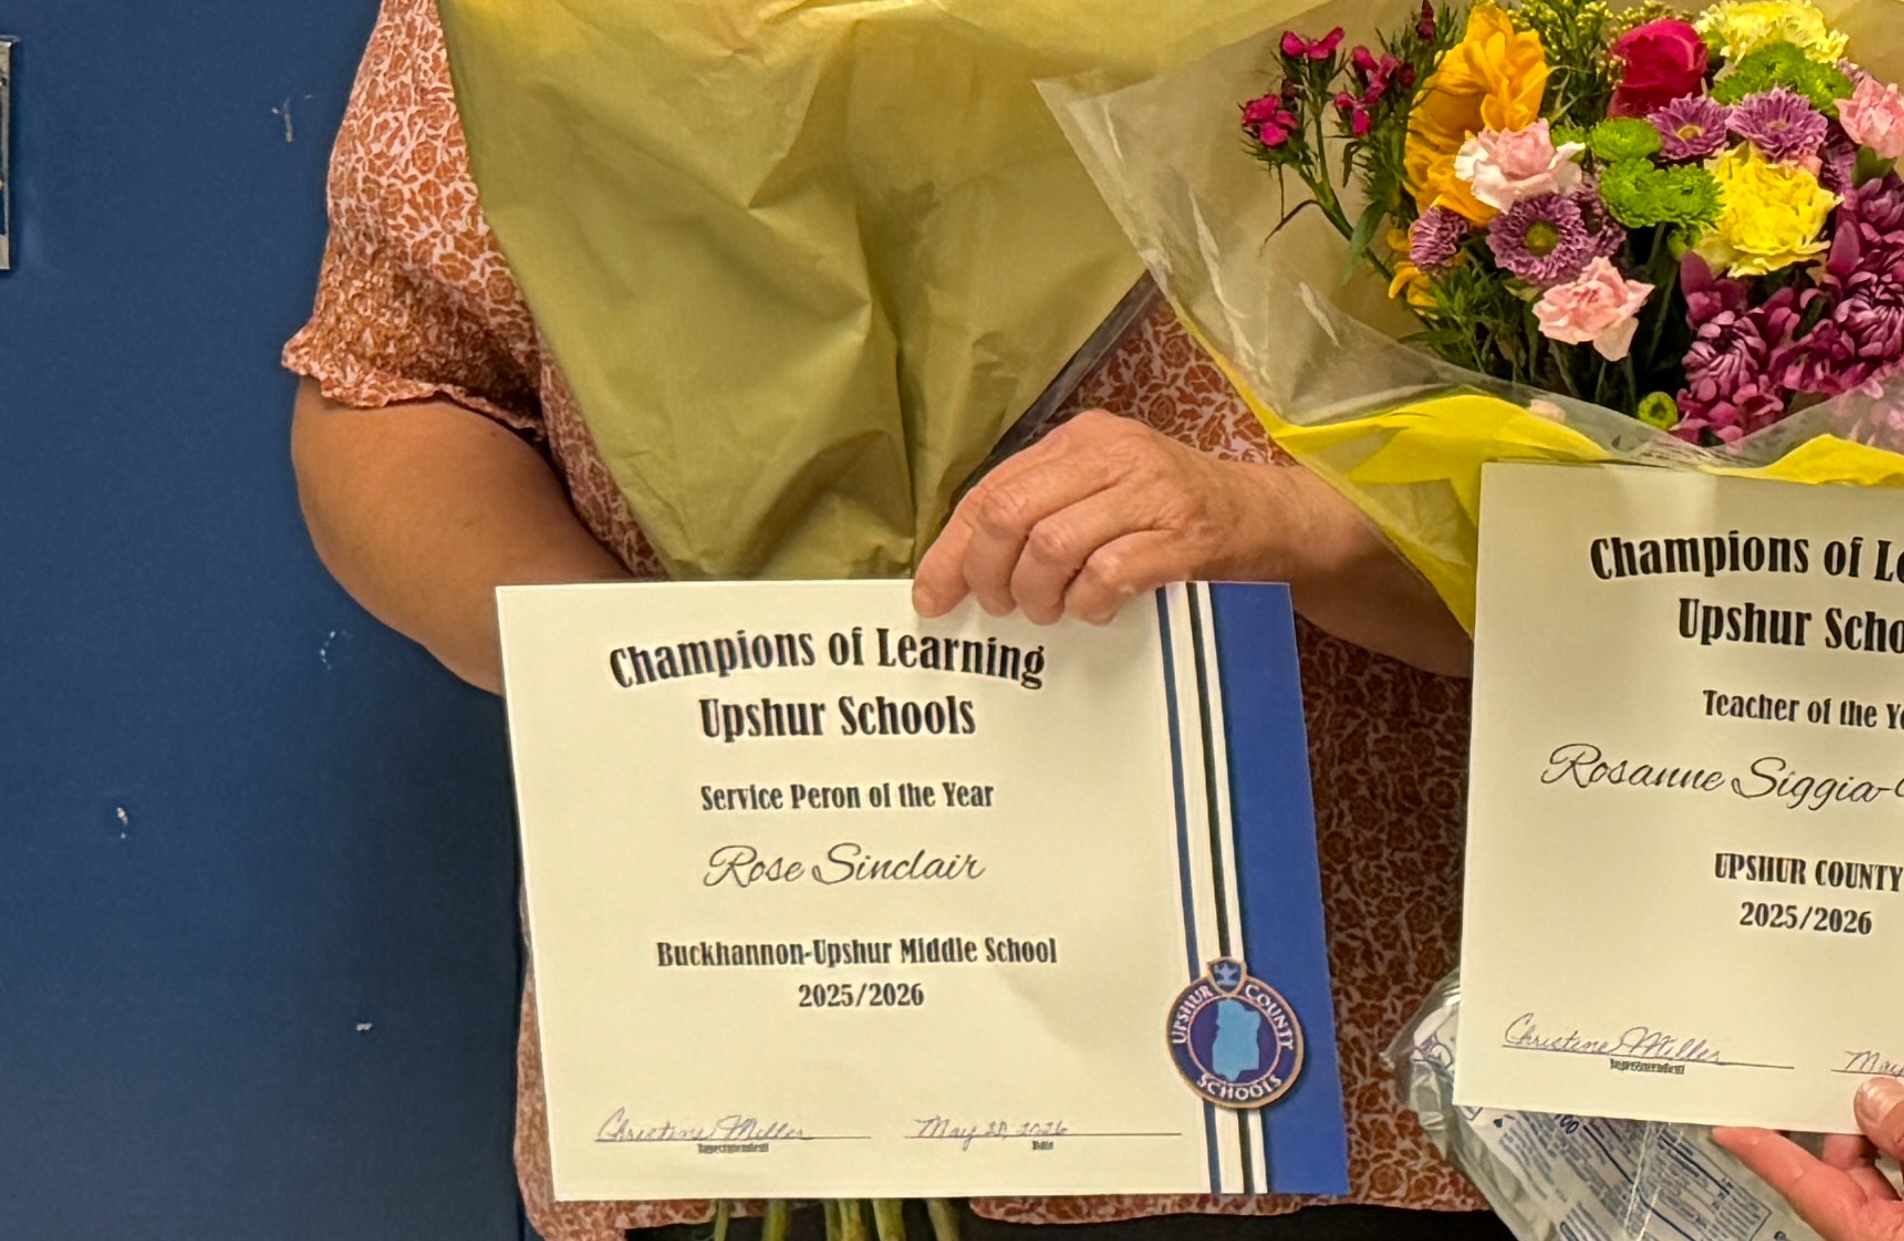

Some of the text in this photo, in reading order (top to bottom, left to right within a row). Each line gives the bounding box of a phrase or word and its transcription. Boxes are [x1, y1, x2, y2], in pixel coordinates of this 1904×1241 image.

[1591, 530, 1809, 579] Champions
[1824, 537, 1863, 578] of
[1679, 598, 1812, 646] Upshur
[610, 627, 1044, 690] Champions of Learning
[699, 695, 975, 743] Upshur Schools
[1703, 690, 1800, 722] Teacher
[1807, 698, 1831, 724] of
[1840, 701, 1877, 727] the
[1541, 744, 1725, 791] Rosanne
[701, 782, 994, 811] Service Peron of the Year
[703, 843, 985, 888] Rose Sinclair
[1715, 853, 1903, 892] UPSHUR COUNTY
[1740, 902, 1872, 935] 2025/2026
[657, 937, 1057, 968] Buckhannon-Upshur Middle School
[799, 983, 924, 1007] 2025/2026
[1172, 984, 1213, 1044] UPSHUR
[1245, 985, 1293, 1050] COUNTY
[1197, 1074, 1282, 1099] SCHOOLS
